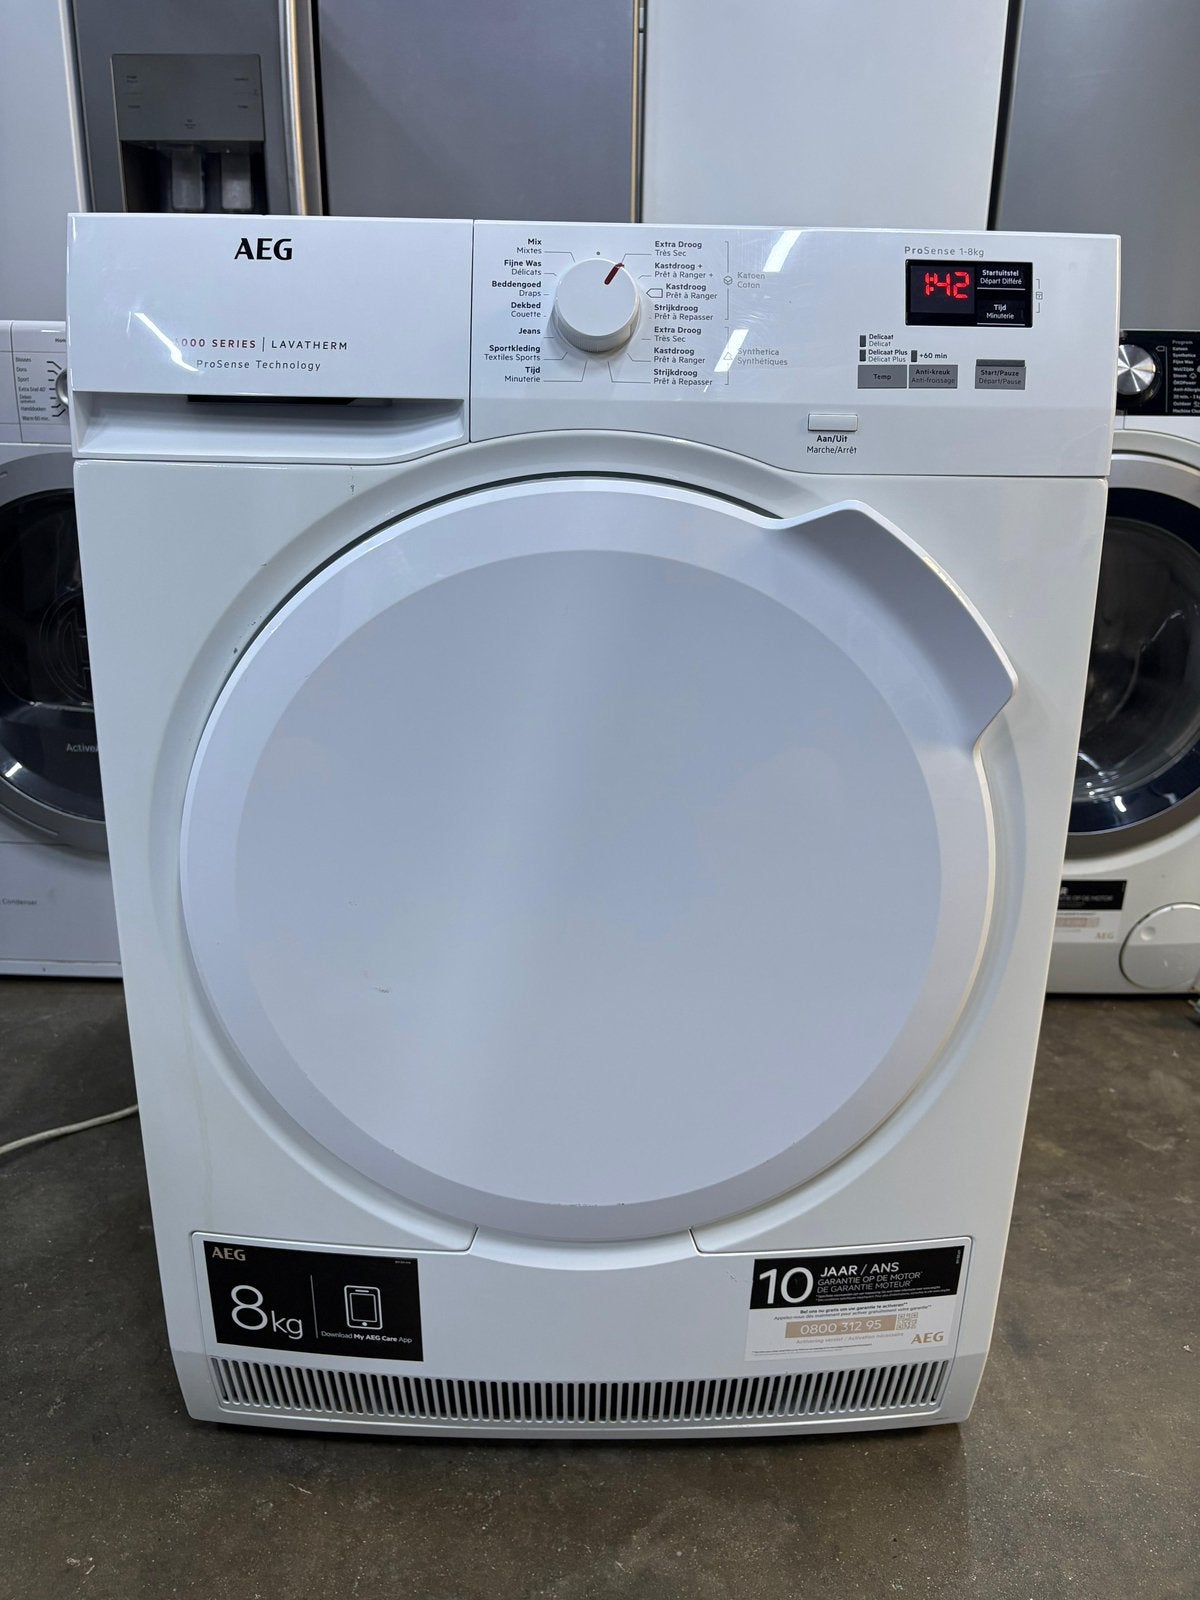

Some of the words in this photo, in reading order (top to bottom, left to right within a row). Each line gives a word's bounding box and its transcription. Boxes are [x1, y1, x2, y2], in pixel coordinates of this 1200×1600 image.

[234, 237, 292, 260] AEG
[678, 241, 702, 249] Droog
[904, 246, 955, 255] ProSense
[960, 248, 984, 257] 1-8kg
[504, 259, 523, 267] Fijne
[654, 262, 695, 270] Kastdroog
[679, 271, 706, 279] Ranger
[492, 280, 541, 288] Beddengoed
[924, 271, 969, 299] 1:42
[980, 277, 1000, 285] Départ
[666, 283, 706, 291] Kastdroog
[690, 292, 717, 300] Ranger
[654, 304, 698, 312] Strijkdroog
[679, 313, 713, 321] Repasser
[677, 326, 701, 335] Droog
[175, 338, 205, 346] 000
[212, 339, 255, 348] SERIES
[271, 340, 347, 349] LAVATHERM
[489, 344, 540, 353] Sportkleding
[654, 347, 694, 355] Kastdroog
[737, 348, 779, 356] Synthetica
[196, 359, 249, 368] ProSense
[256, 360, 320, 371] Technology
[679, 357, 705, 365] Ranger
[737, 357, 787, 366] Synthétiques
[525, 366, 540, 374] Tijd
[654, 369, 697, 377] Strijkdroog
[679, 378, 712, 386] Repasser
[816, 435, 847, 443] Aan/Uit
[806, 445, 857, 454] Marche/Arrêt
[212, 1246, 246, 1261] AEG
[820, 1265, 857, 1277] JAAR
[860, 1263, 867, 1275] /
[870, 1261, 899, 1273] ANS
[817, 1276, 860, 1285] GARANTIE
[759, 1266, 813, 1305] 10
[817, 1285, 828, 1293] DE
[830, 1282, 873, 1292] GARANTIE
[230, 1284, 303, 1339] 8kg
[800, 1322, 837, 1334] 0800
[840, 1321, 862, 1332] 312
[866, 1319, 881, 1329] 95
[321, 1330, 352, 1338] Download
[911, 1330, 944, 1344] AEG
